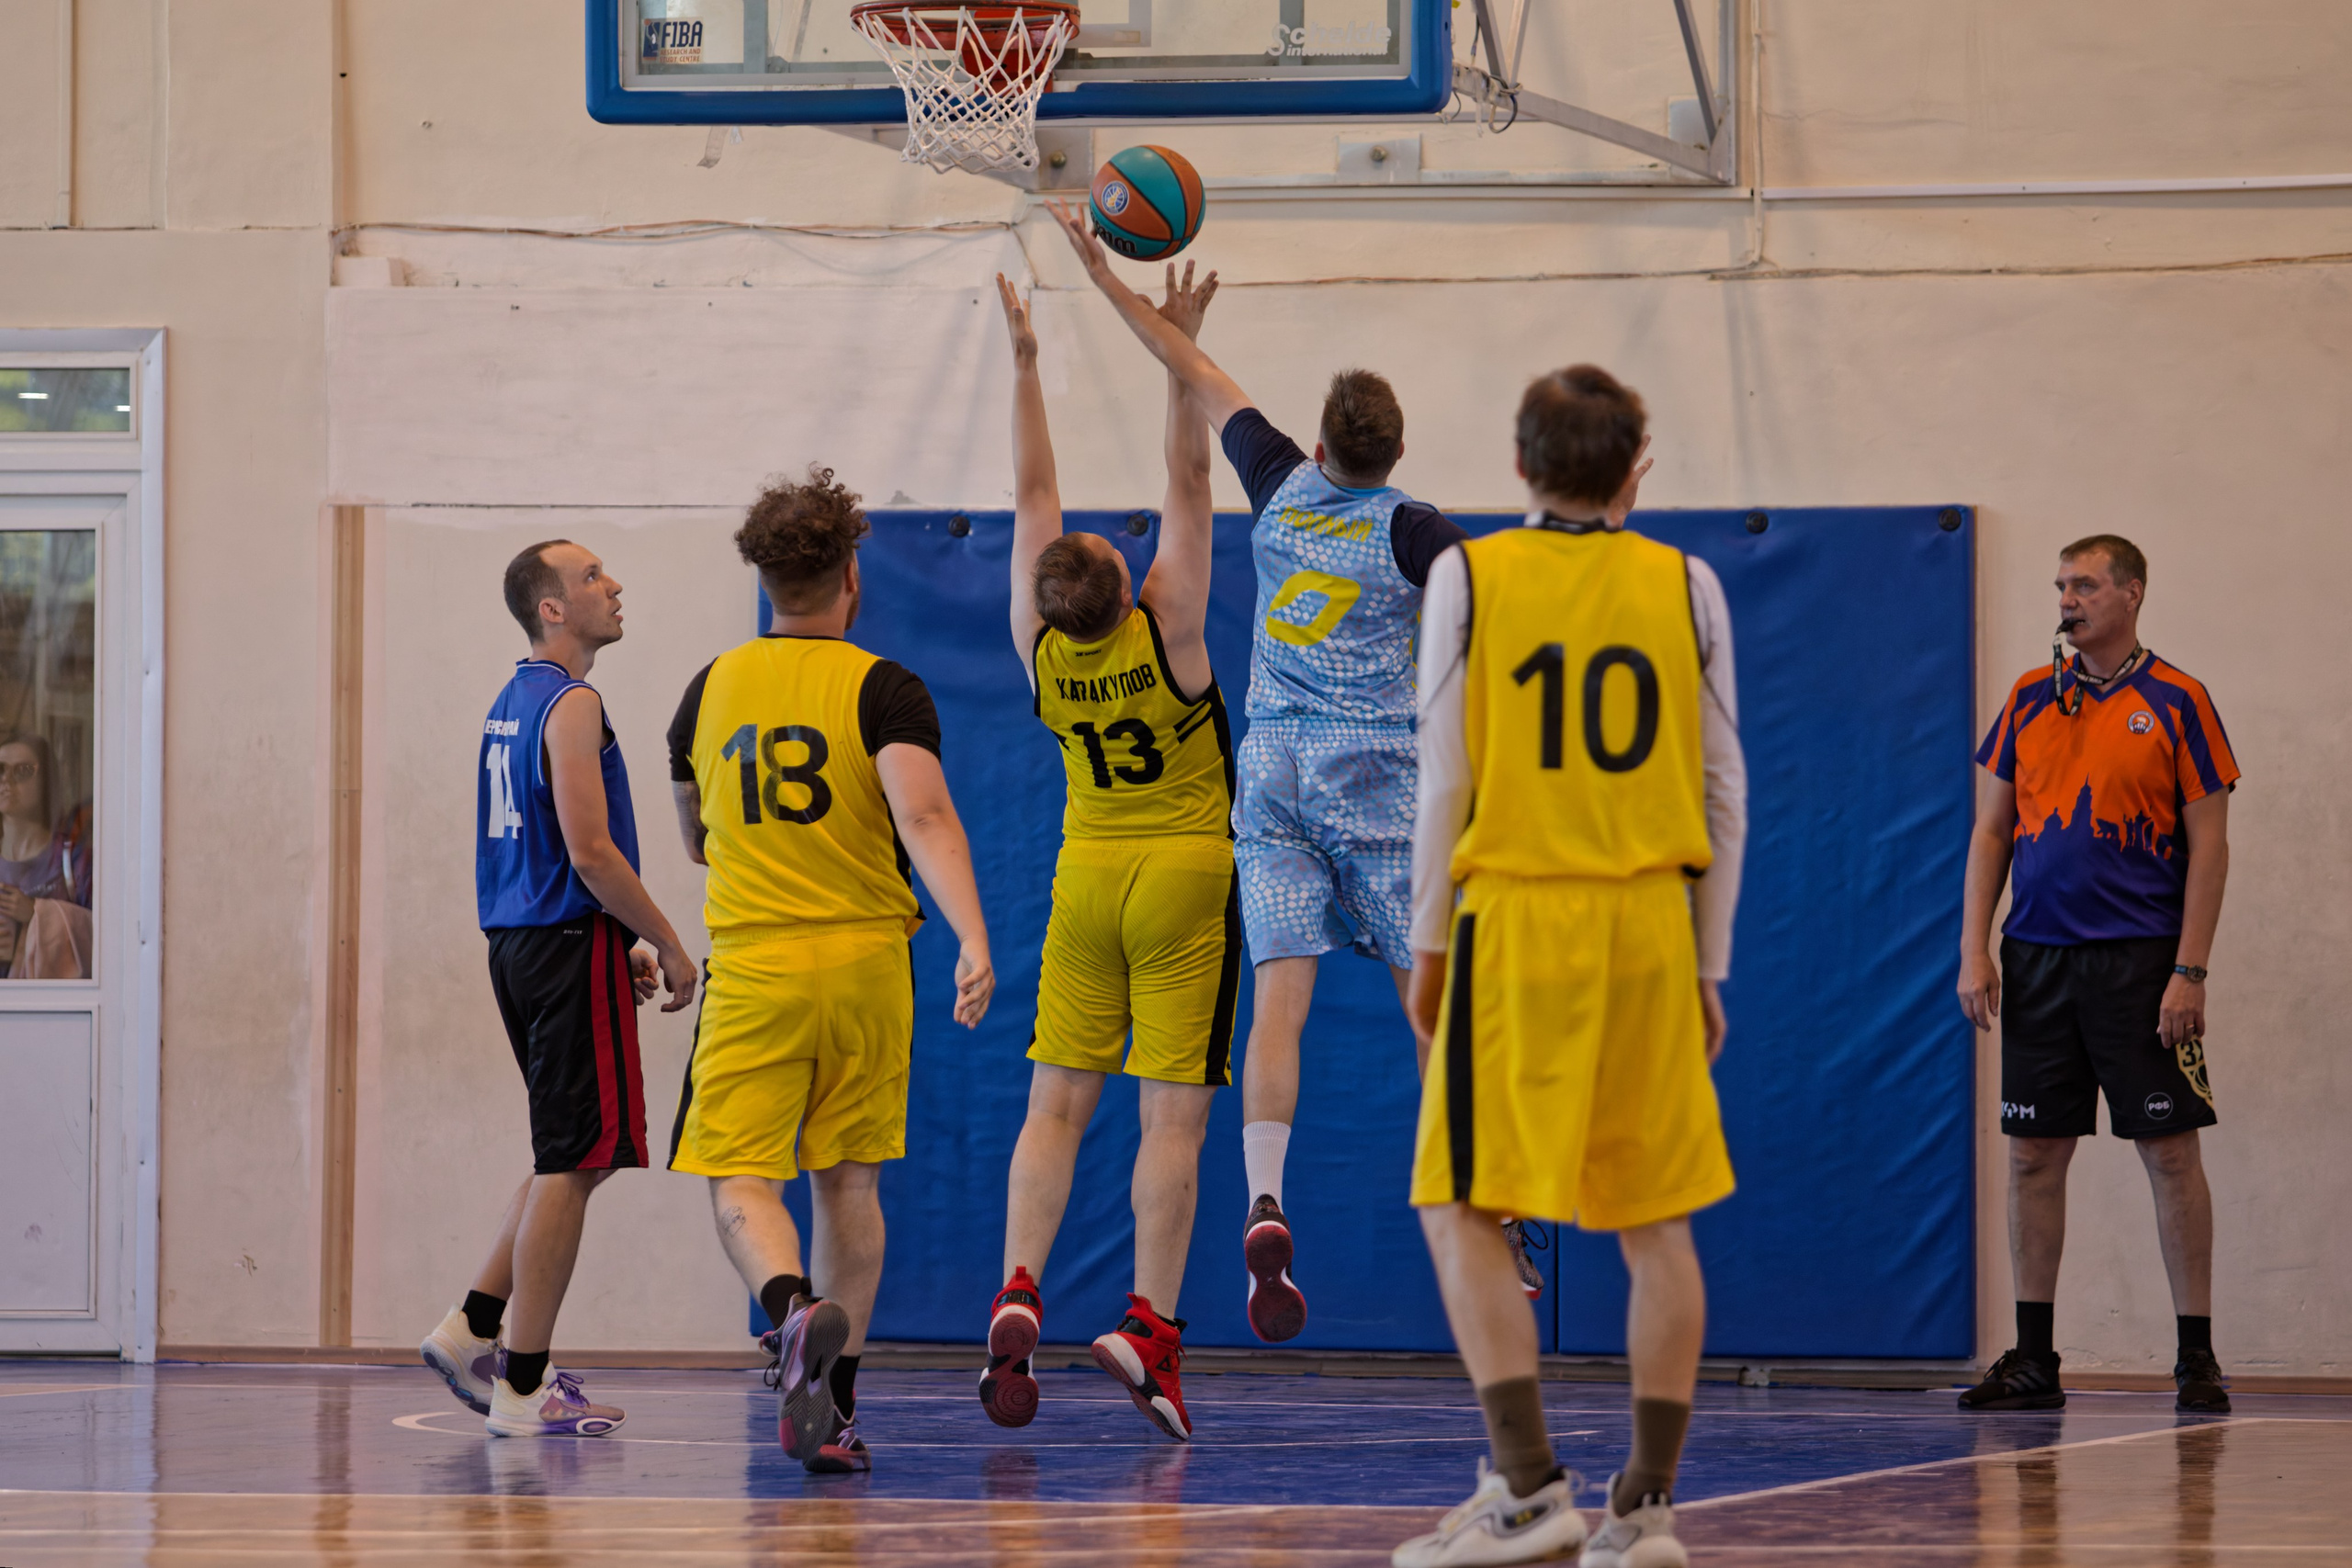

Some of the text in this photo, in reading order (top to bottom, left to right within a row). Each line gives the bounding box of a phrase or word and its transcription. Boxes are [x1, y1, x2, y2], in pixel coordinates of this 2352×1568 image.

[662, 21, 703, 48] FIBA
[1277, 506, 1374, 542] ПОЛНЫЙ
[1511, 641, 1659, 773] 10
[486, 743, 523, 839] 14
[720, 724, 831, 825] 18
[1071, 718, 1164, 788] 13
